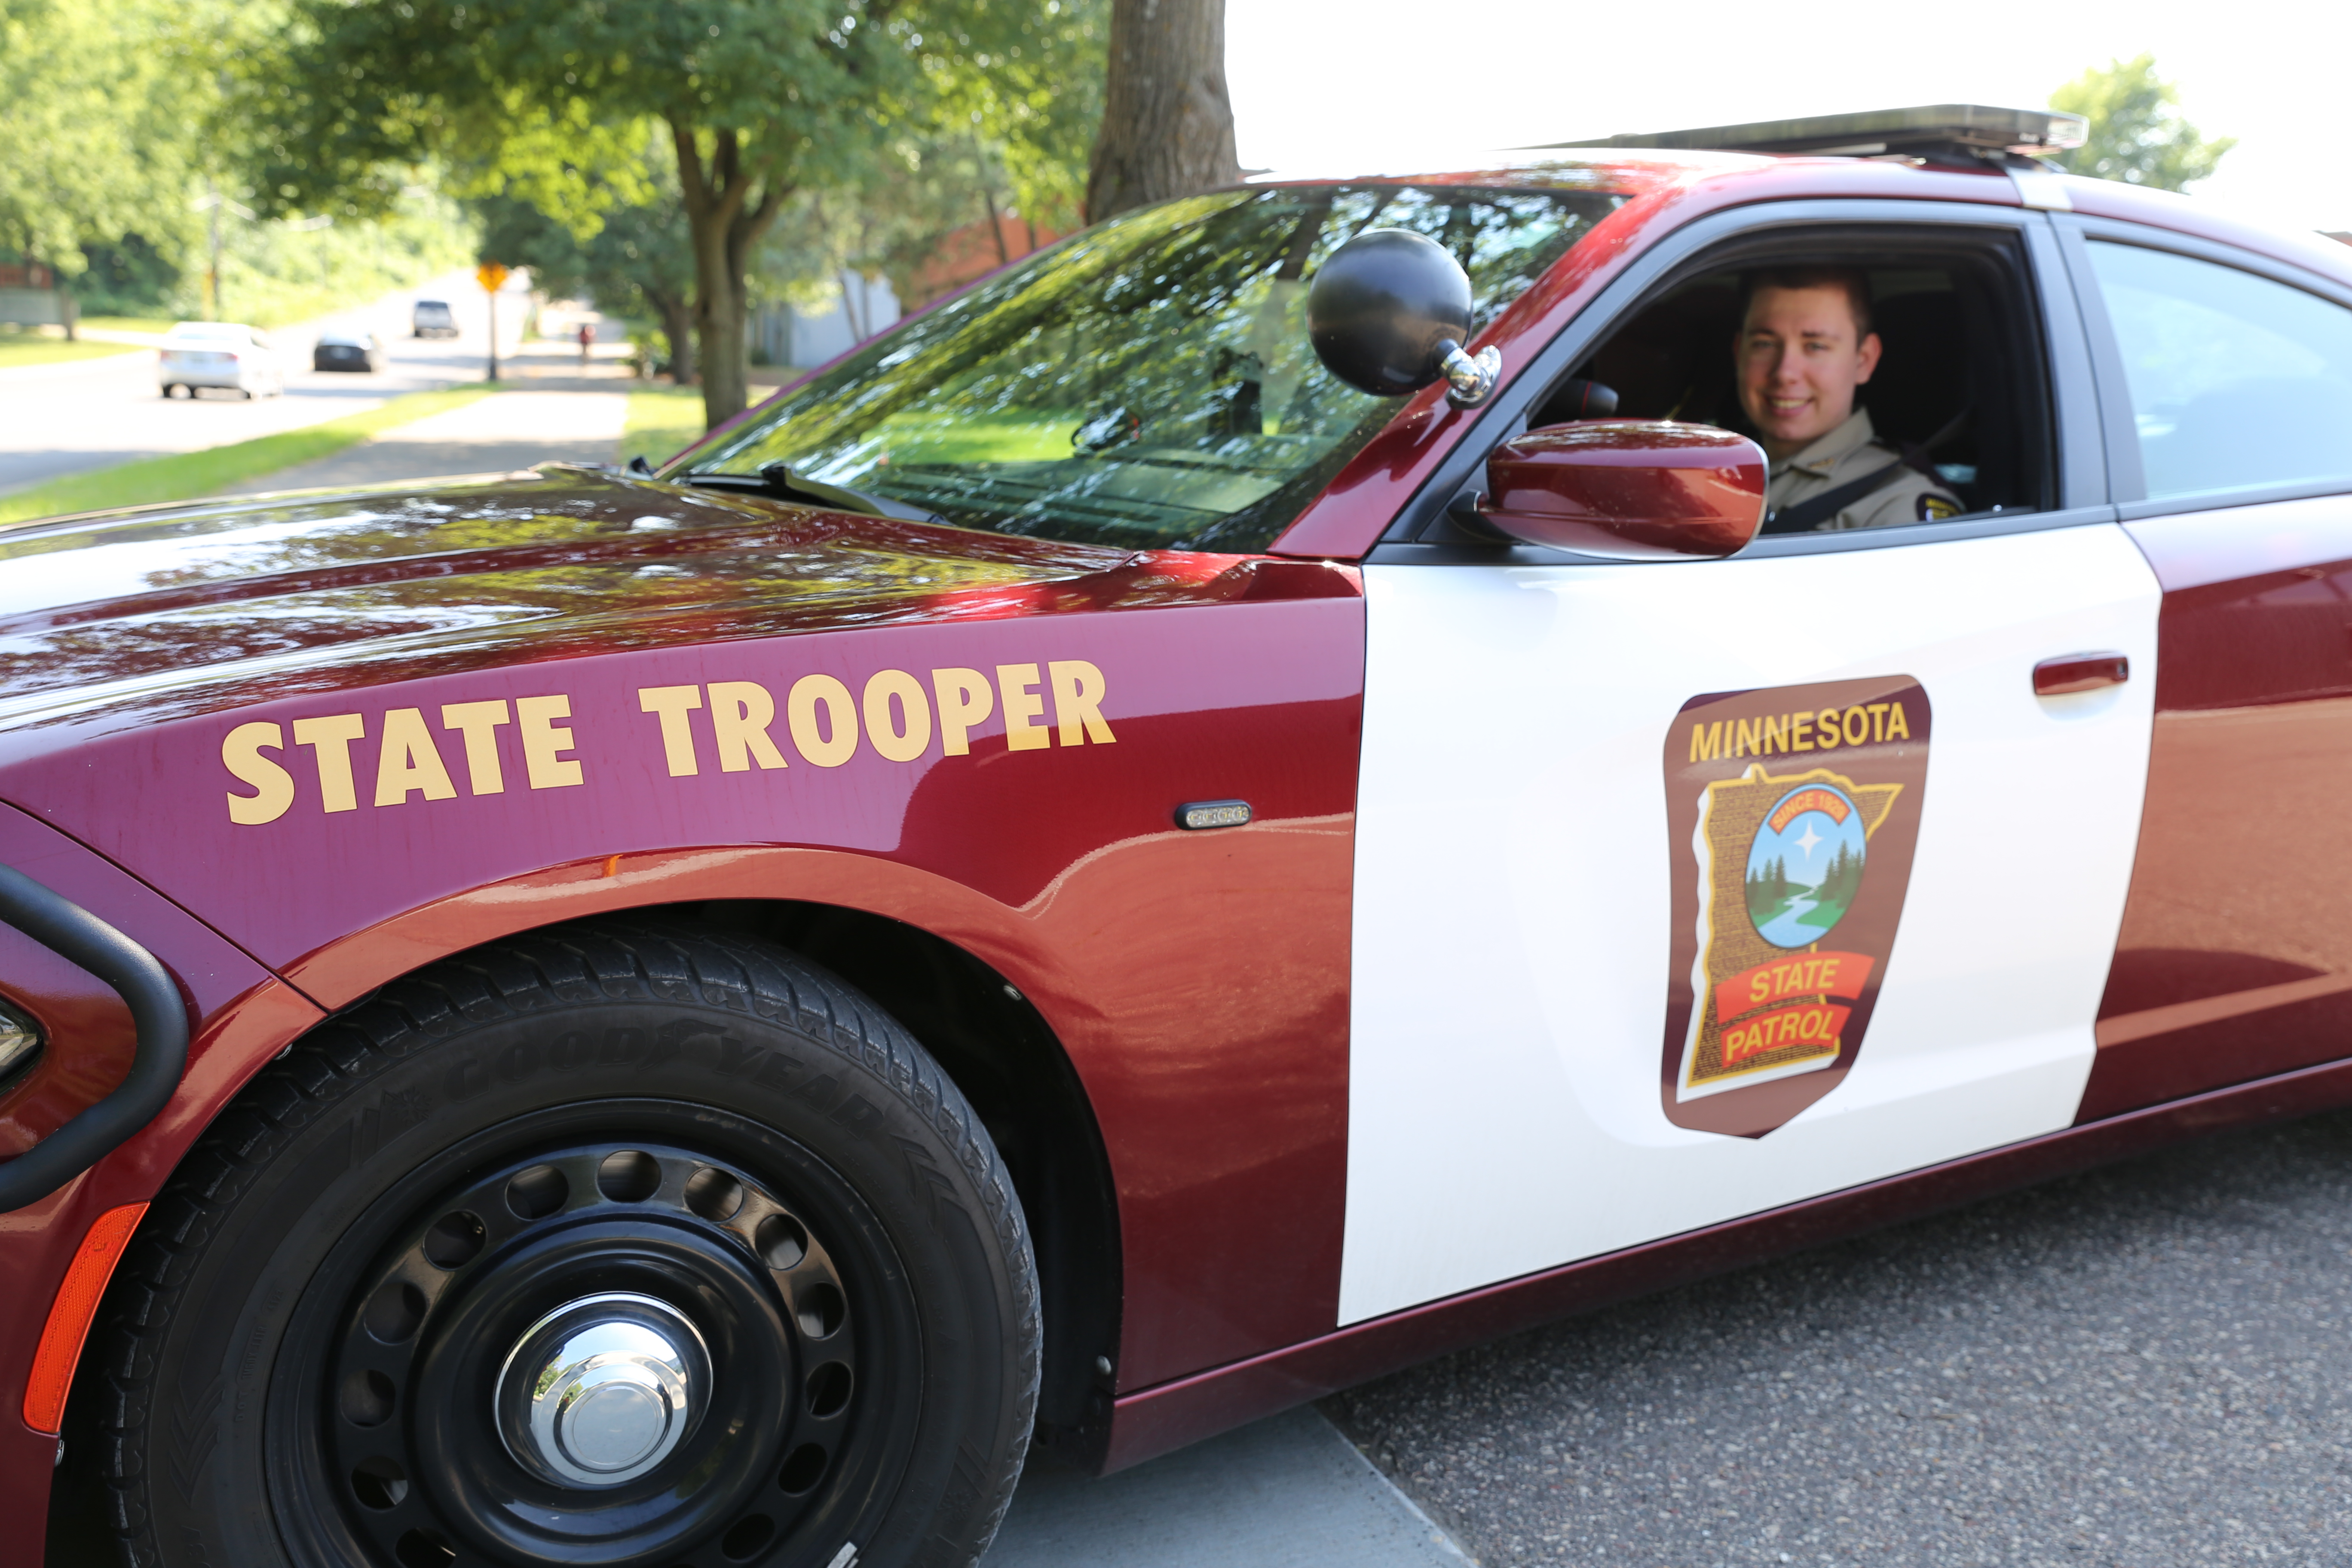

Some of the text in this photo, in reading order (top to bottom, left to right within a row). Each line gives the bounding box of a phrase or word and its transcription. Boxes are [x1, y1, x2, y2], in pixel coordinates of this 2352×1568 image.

[221, 659, 1117, 826] STATE TROOPER
[1689, 701, 1910, 763] MINNESOTA
[1773, 792, 1815, 830] SINCE
[1749, 958, 1841, 1003] STATE
[1725, 1009, 1835, 1062] PATROL
